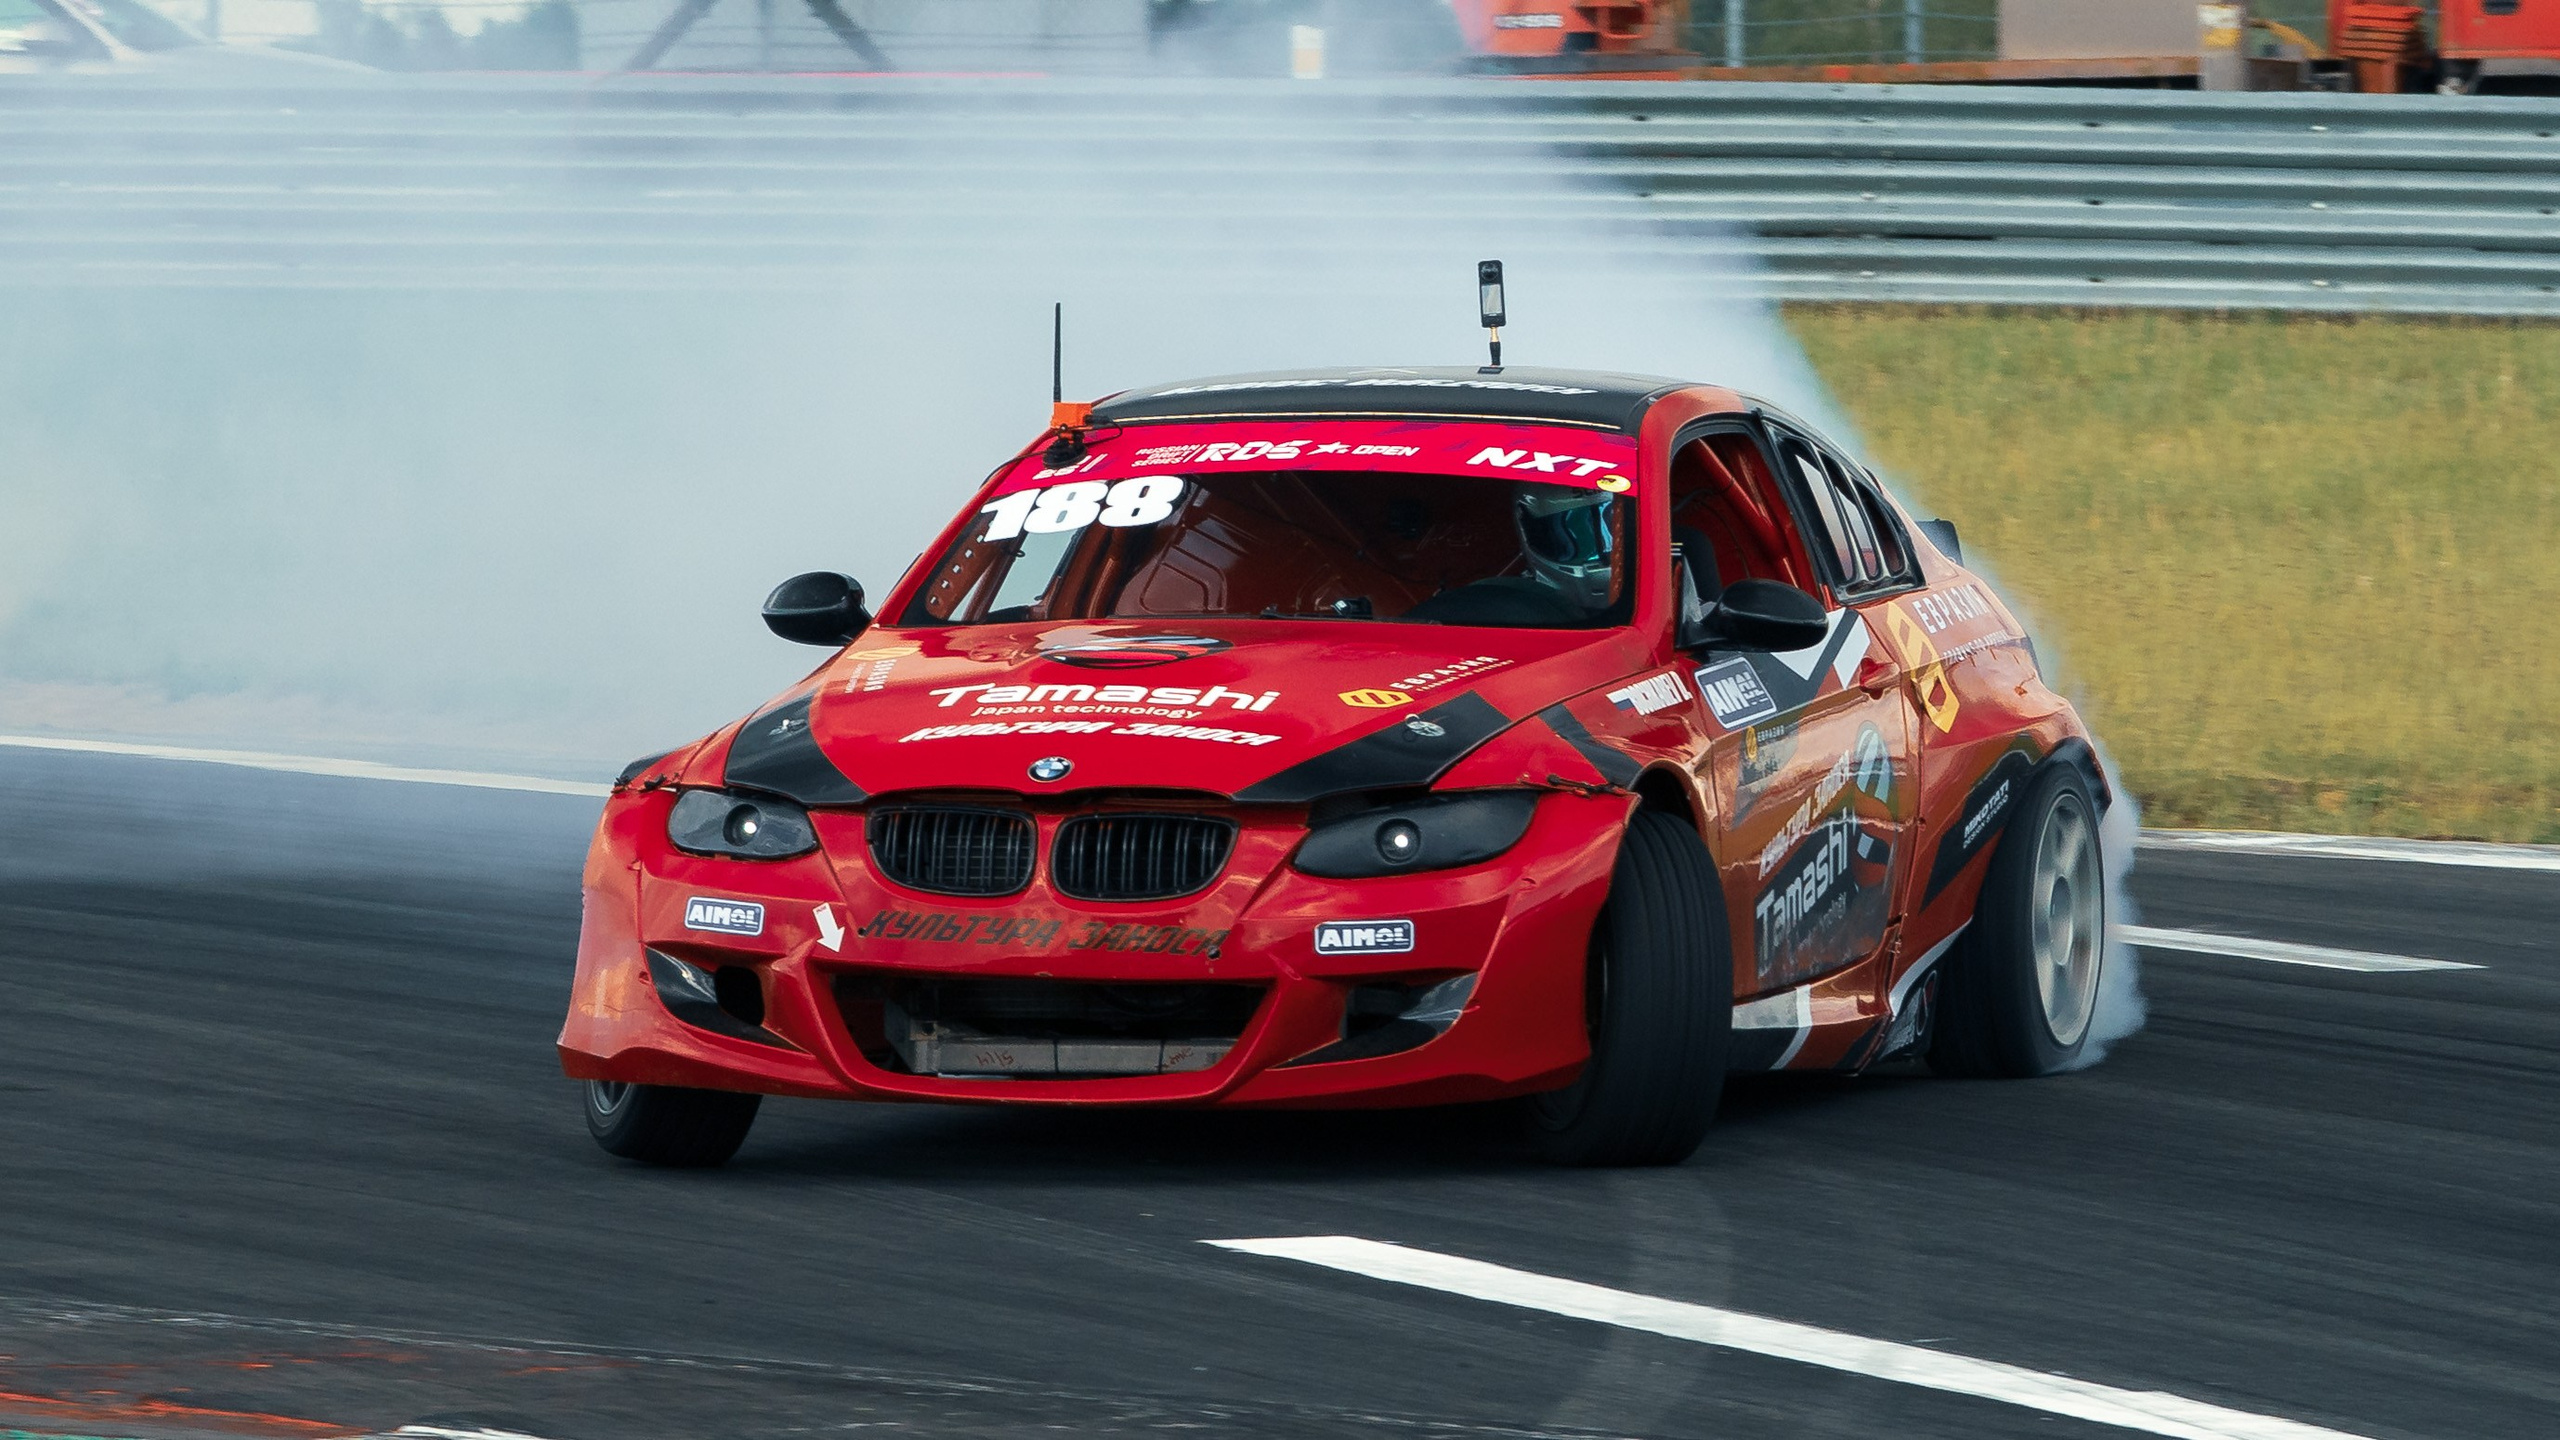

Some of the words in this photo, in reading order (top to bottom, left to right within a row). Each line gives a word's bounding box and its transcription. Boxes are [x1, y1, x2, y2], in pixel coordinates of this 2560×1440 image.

[1131, 456, 1184, 467] SERIES
[1135, 444, 1200, 455] RUSSIAN
[1147, 450, 1192, 461] DRIFT
[1194, 440, 1313, 462] RDS
[1351, 444, 1420, 457] OPEN
[1466, 447, 1618, 476] NXT
[980, 475, 1184, 542] 188
[1389, 656, 1500, 689] ЕВРАЗИЯ
[930, 683, 1281, 712] Tamashi
[1704, 671, 1769, 717] AIMOL
[1053, 702, 1203, 719] technology
[899, 721, 1115, 743] КУЛЬТУРА
[1111, 722, 1282, 746] ЗАНОСА
[1756, 806, 1848, 961] Tamashi
[688, 904, 759, 929] AIMOL
[865, 910, 1062, 947] КУЛЬТУРА
[1068, 921, 1231, 957] ЗАНОСА
[1320, 927, 1409, 947] AIMOL
